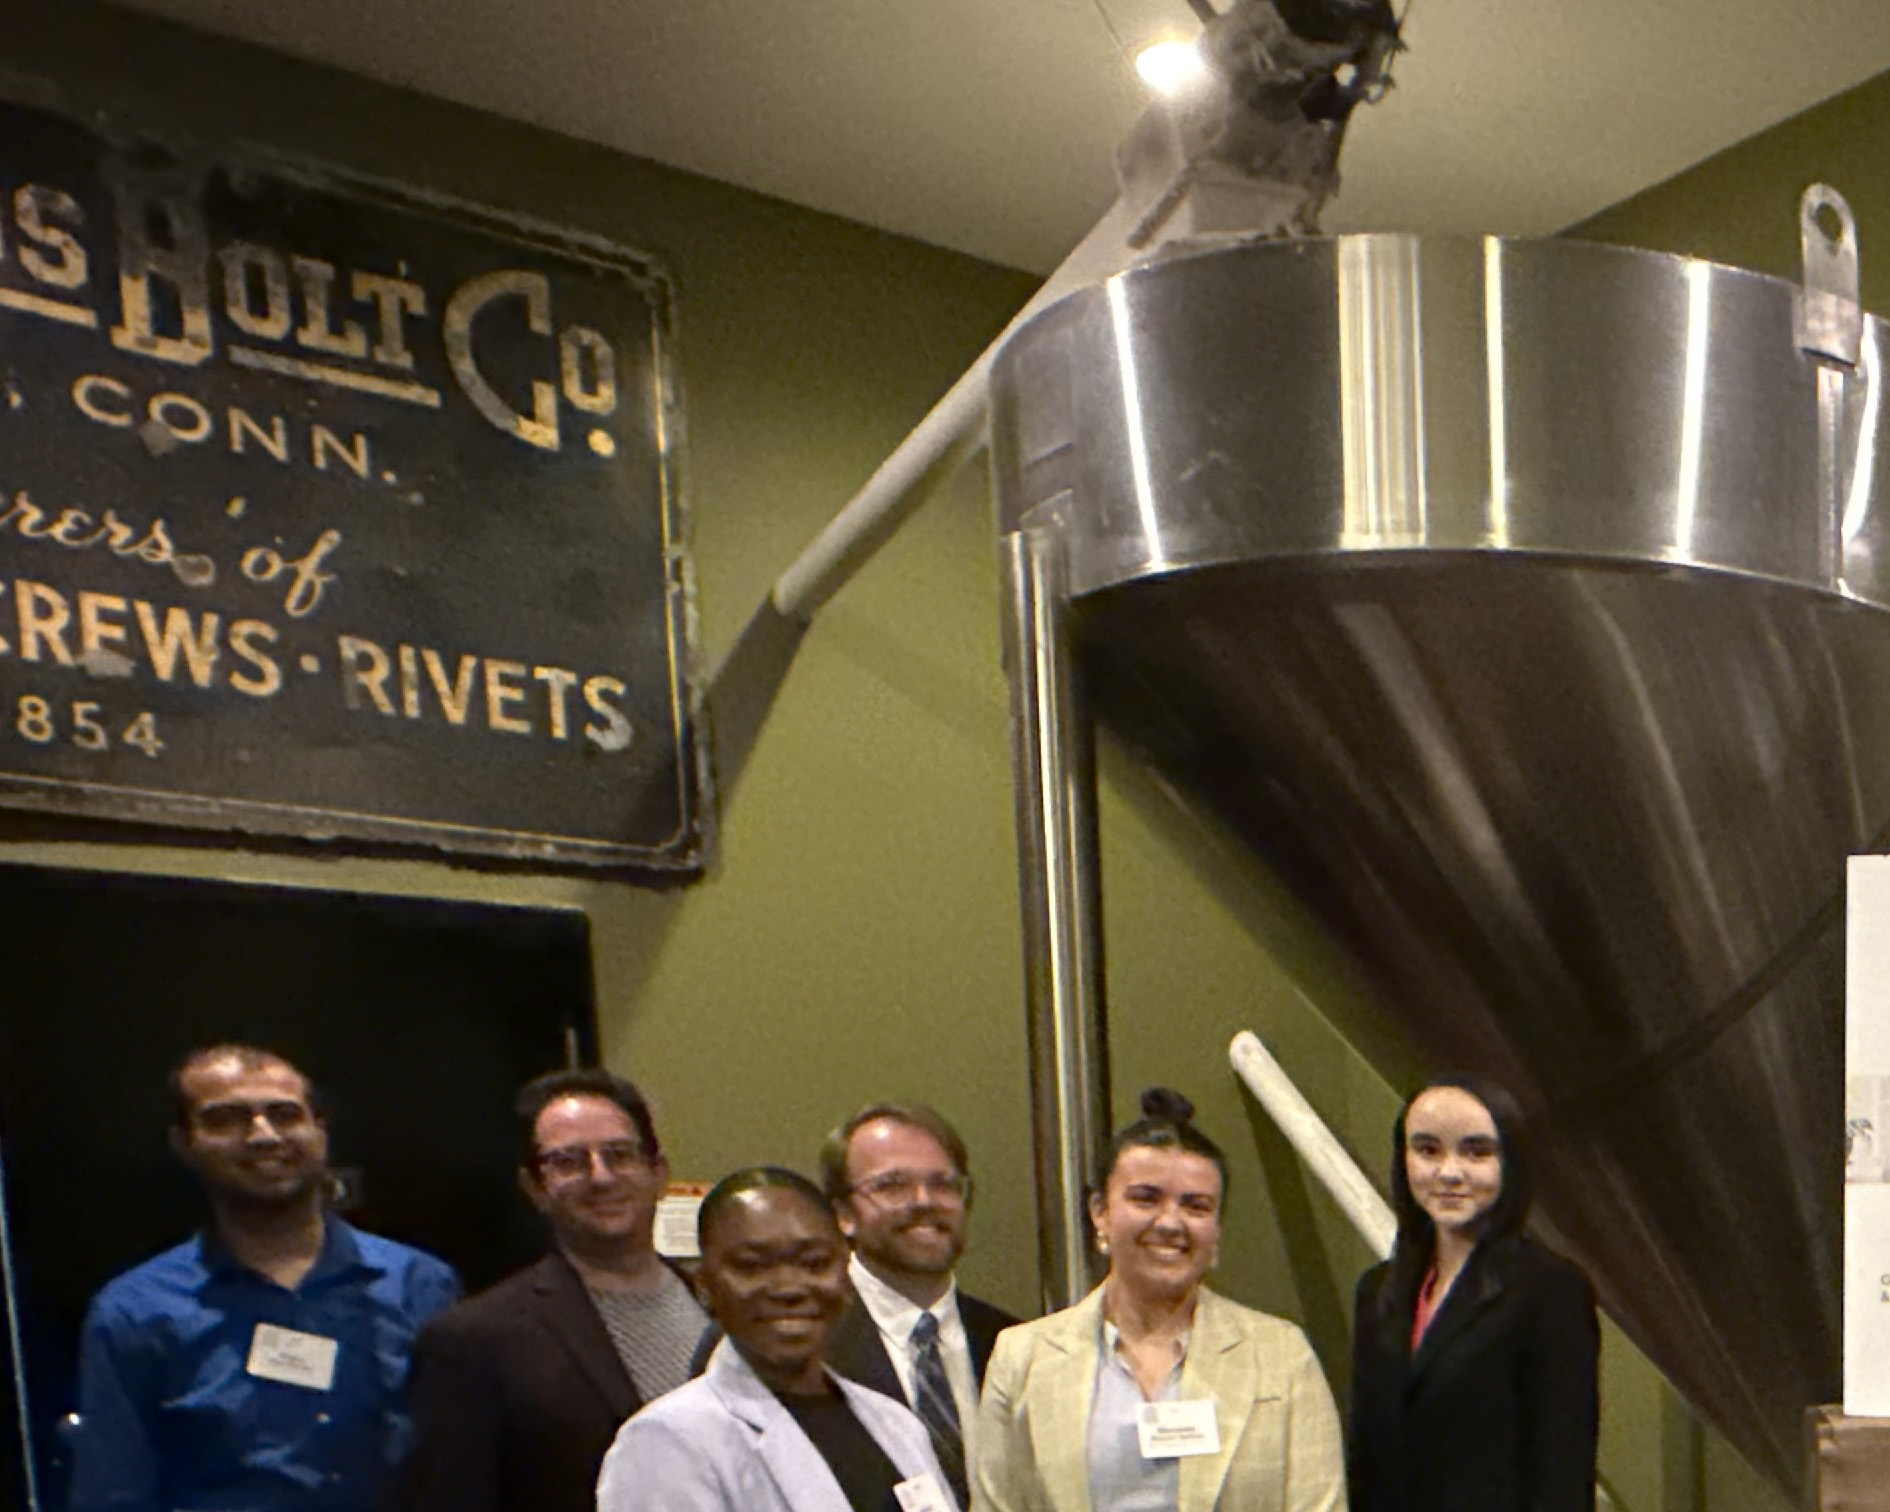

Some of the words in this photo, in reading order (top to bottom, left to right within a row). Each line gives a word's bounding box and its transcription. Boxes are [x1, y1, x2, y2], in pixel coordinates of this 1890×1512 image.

[71, 373, 397, 484] CONN.
[240, 528, 342, 617] of
[0, 578, 282, 697] REWS
[337, 634, 633, 752] RIVETS
